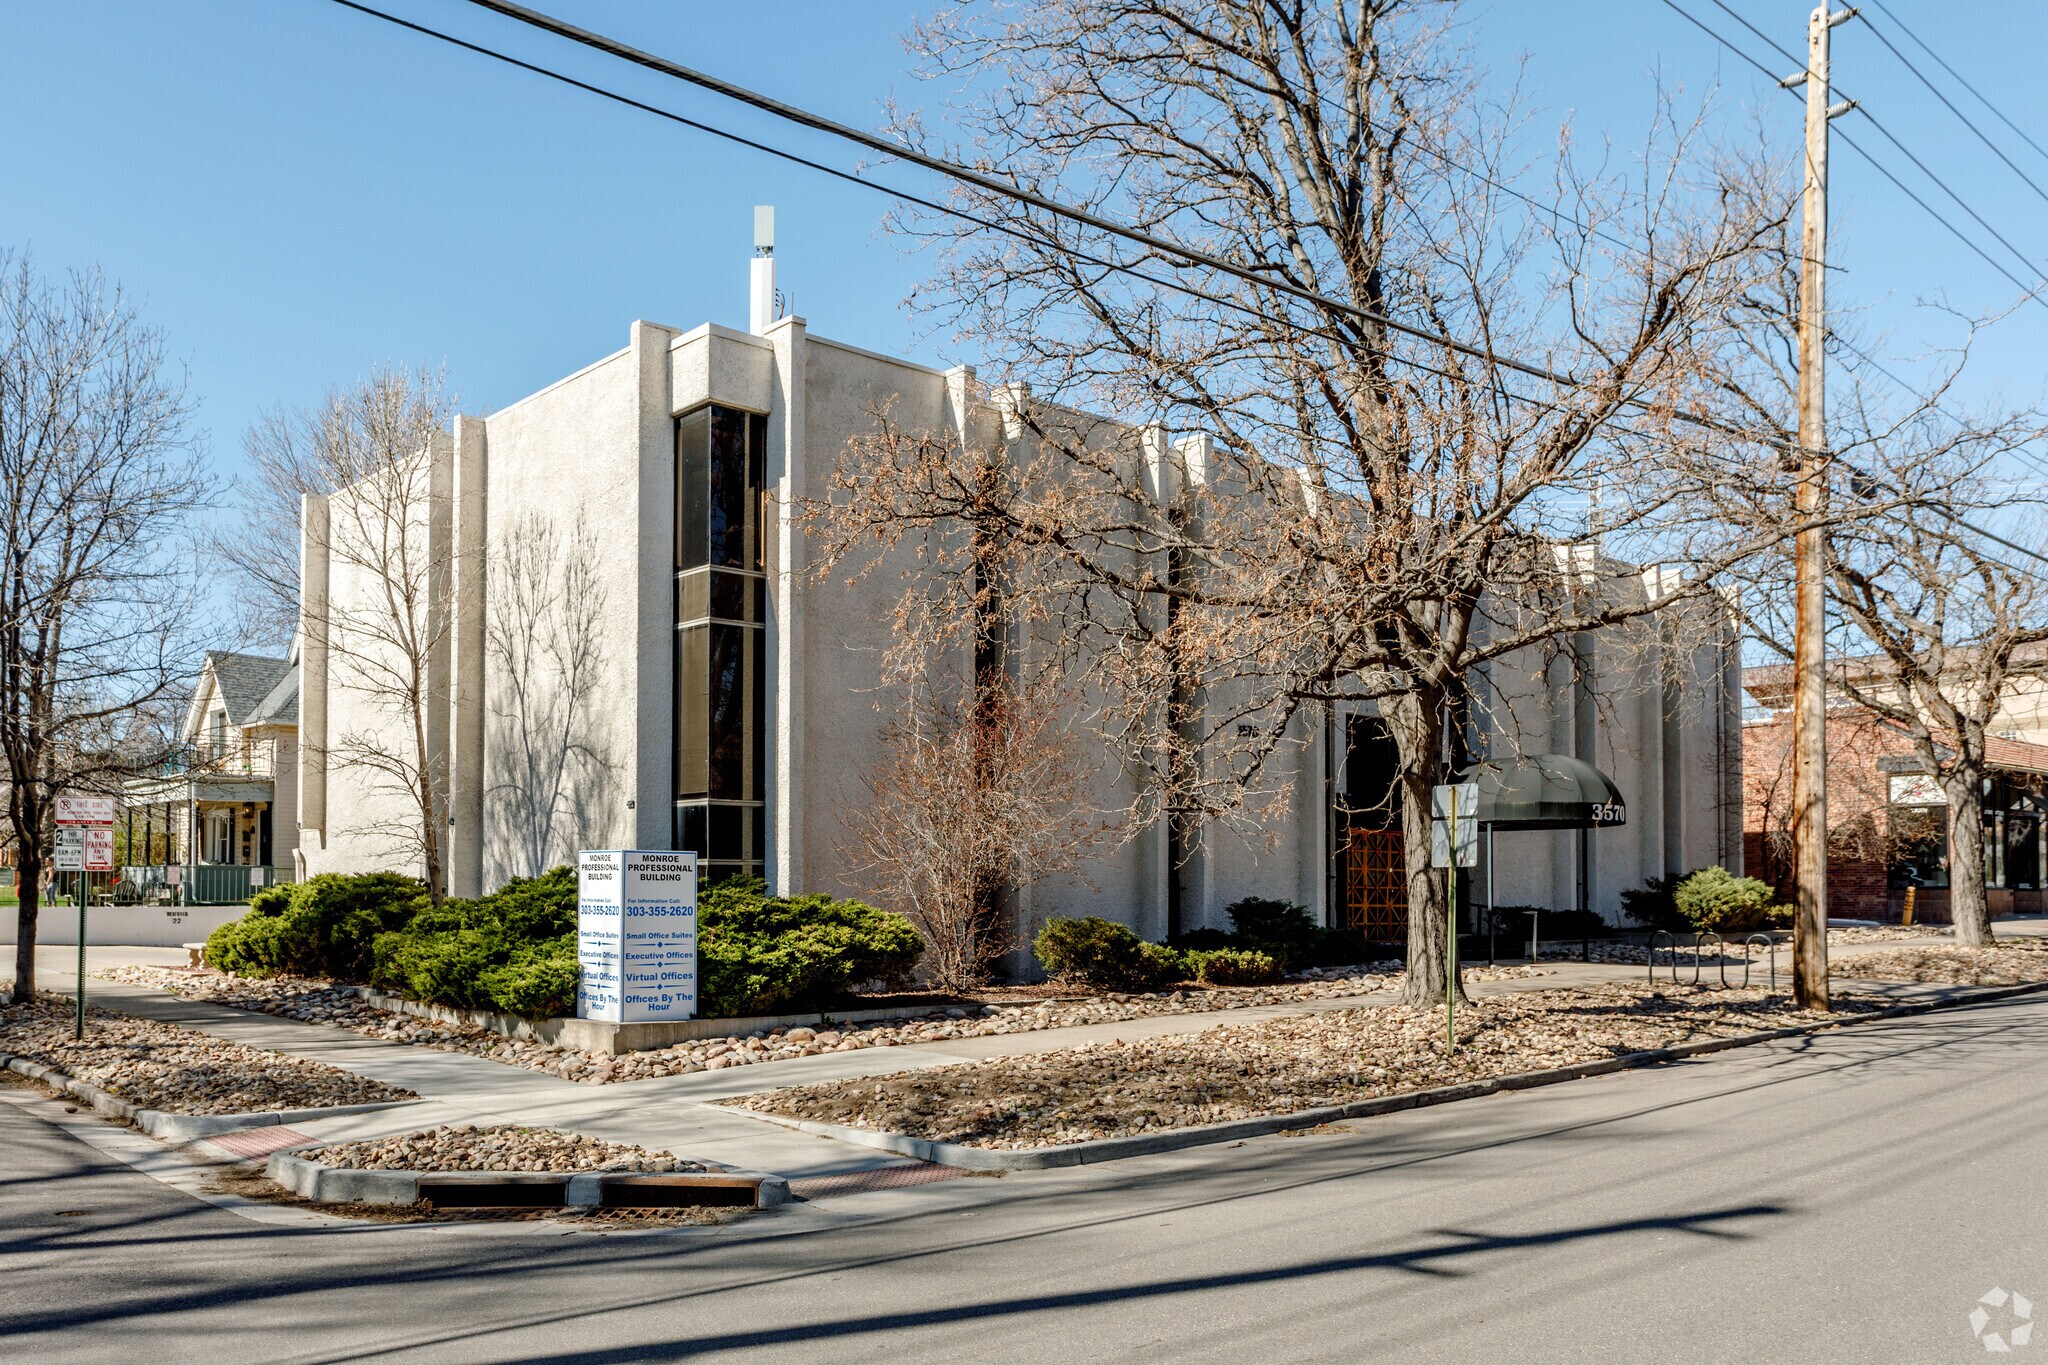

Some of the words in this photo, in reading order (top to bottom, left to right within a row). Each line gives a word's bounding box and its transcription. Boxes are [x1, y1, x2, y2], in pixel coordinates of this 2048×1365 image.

[92, 801, 104, 809] SIDE
[1592, 803, 1625, 822] 3570
[56, 832, 62, 844] 2
[94, 831, 105, 839] NO
[87, 841, 112, 849] PARKING
[581, 863, 619, 871] PROFESSIONAL
[627, 864, 693, 872] PROFESSIONAL
[640, 873, 681, 881] BUILDING
[580, 905, 619, 915] 303-355-2620
[626, 906, 693, 916] 303-355-2620
[580, 950, 601, 958] Executive
[666, 951, 693, 959] Offices
[580, 971, 598, 979] Virtual
[599, 972, 619, 981] Offices
[625, 973, 658, 981] Virtual
[660, 972, 693, 980] Offices
[579, 991, 598, 1000] Offices
[599, 994, 607, 1003] By
[608, 994, 619, 1003] The
[625, 995, 659, 1003] Offices
[661, 993, 673, 1003] By
[676, 992, 693, 1001] The
[591, 1001, 605, 1010] Hour
[648, 1003, 670, 1011] Hour
